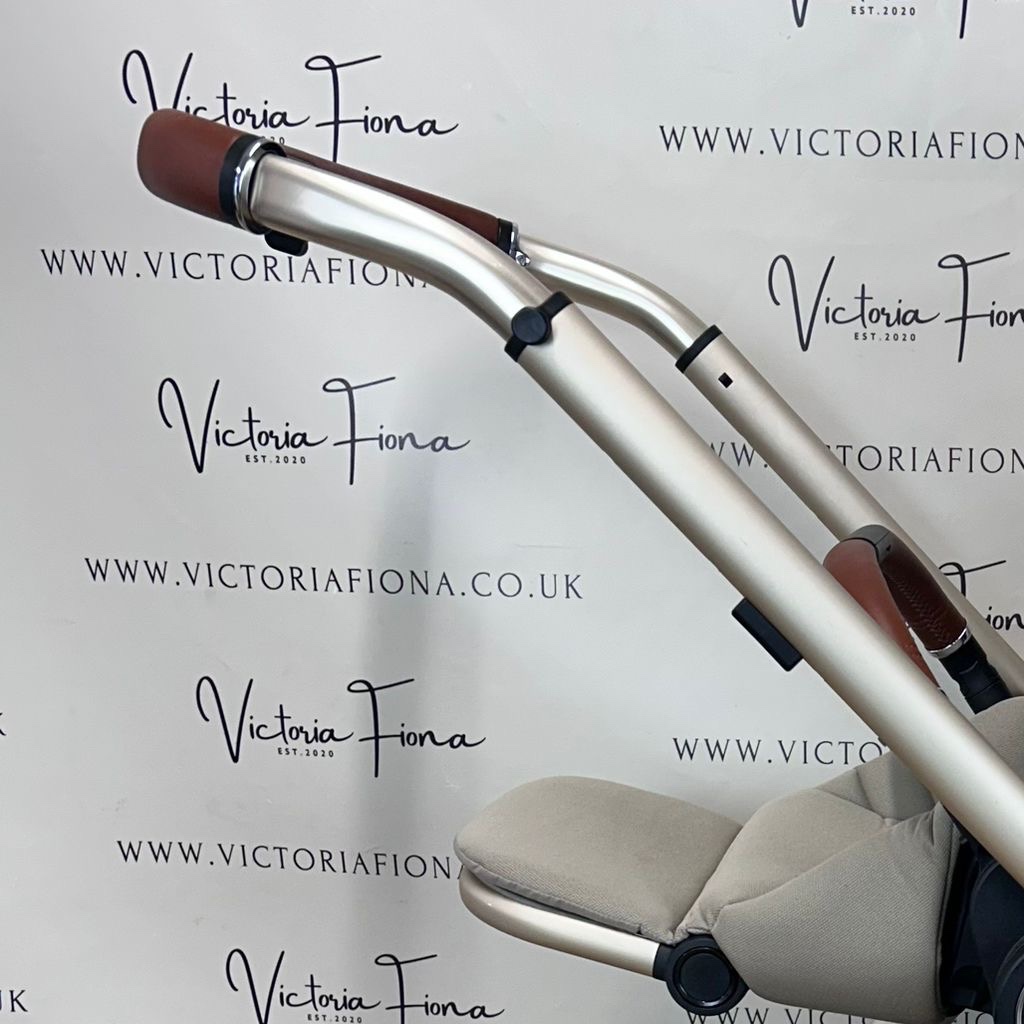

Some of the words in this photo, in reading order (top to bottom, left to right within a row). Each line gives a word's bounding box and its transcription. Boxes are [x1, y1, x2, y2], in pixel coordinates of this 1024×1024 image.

[850, 6, 916, 16] EST.2020
[305, 54, 459, 163] Fiona
[768, 254, 940, 351] Victoria
[853, 333, 917, 341] EST.2020
[158, 377, 328, 474] Victoria
[322, 376, 470, 485] Fiona
[245, 455, 307, 464] EST.2020
[84, 557, 584, 600] WWW.VICTORIAFIONA.CO.UK
[197, 676, 354, 762] Victoria
[347, 678, 486, 777] Fiona
[277, 748, 334, 758] EST.2020
[307, 1014, 363, 1024] EST.2020
